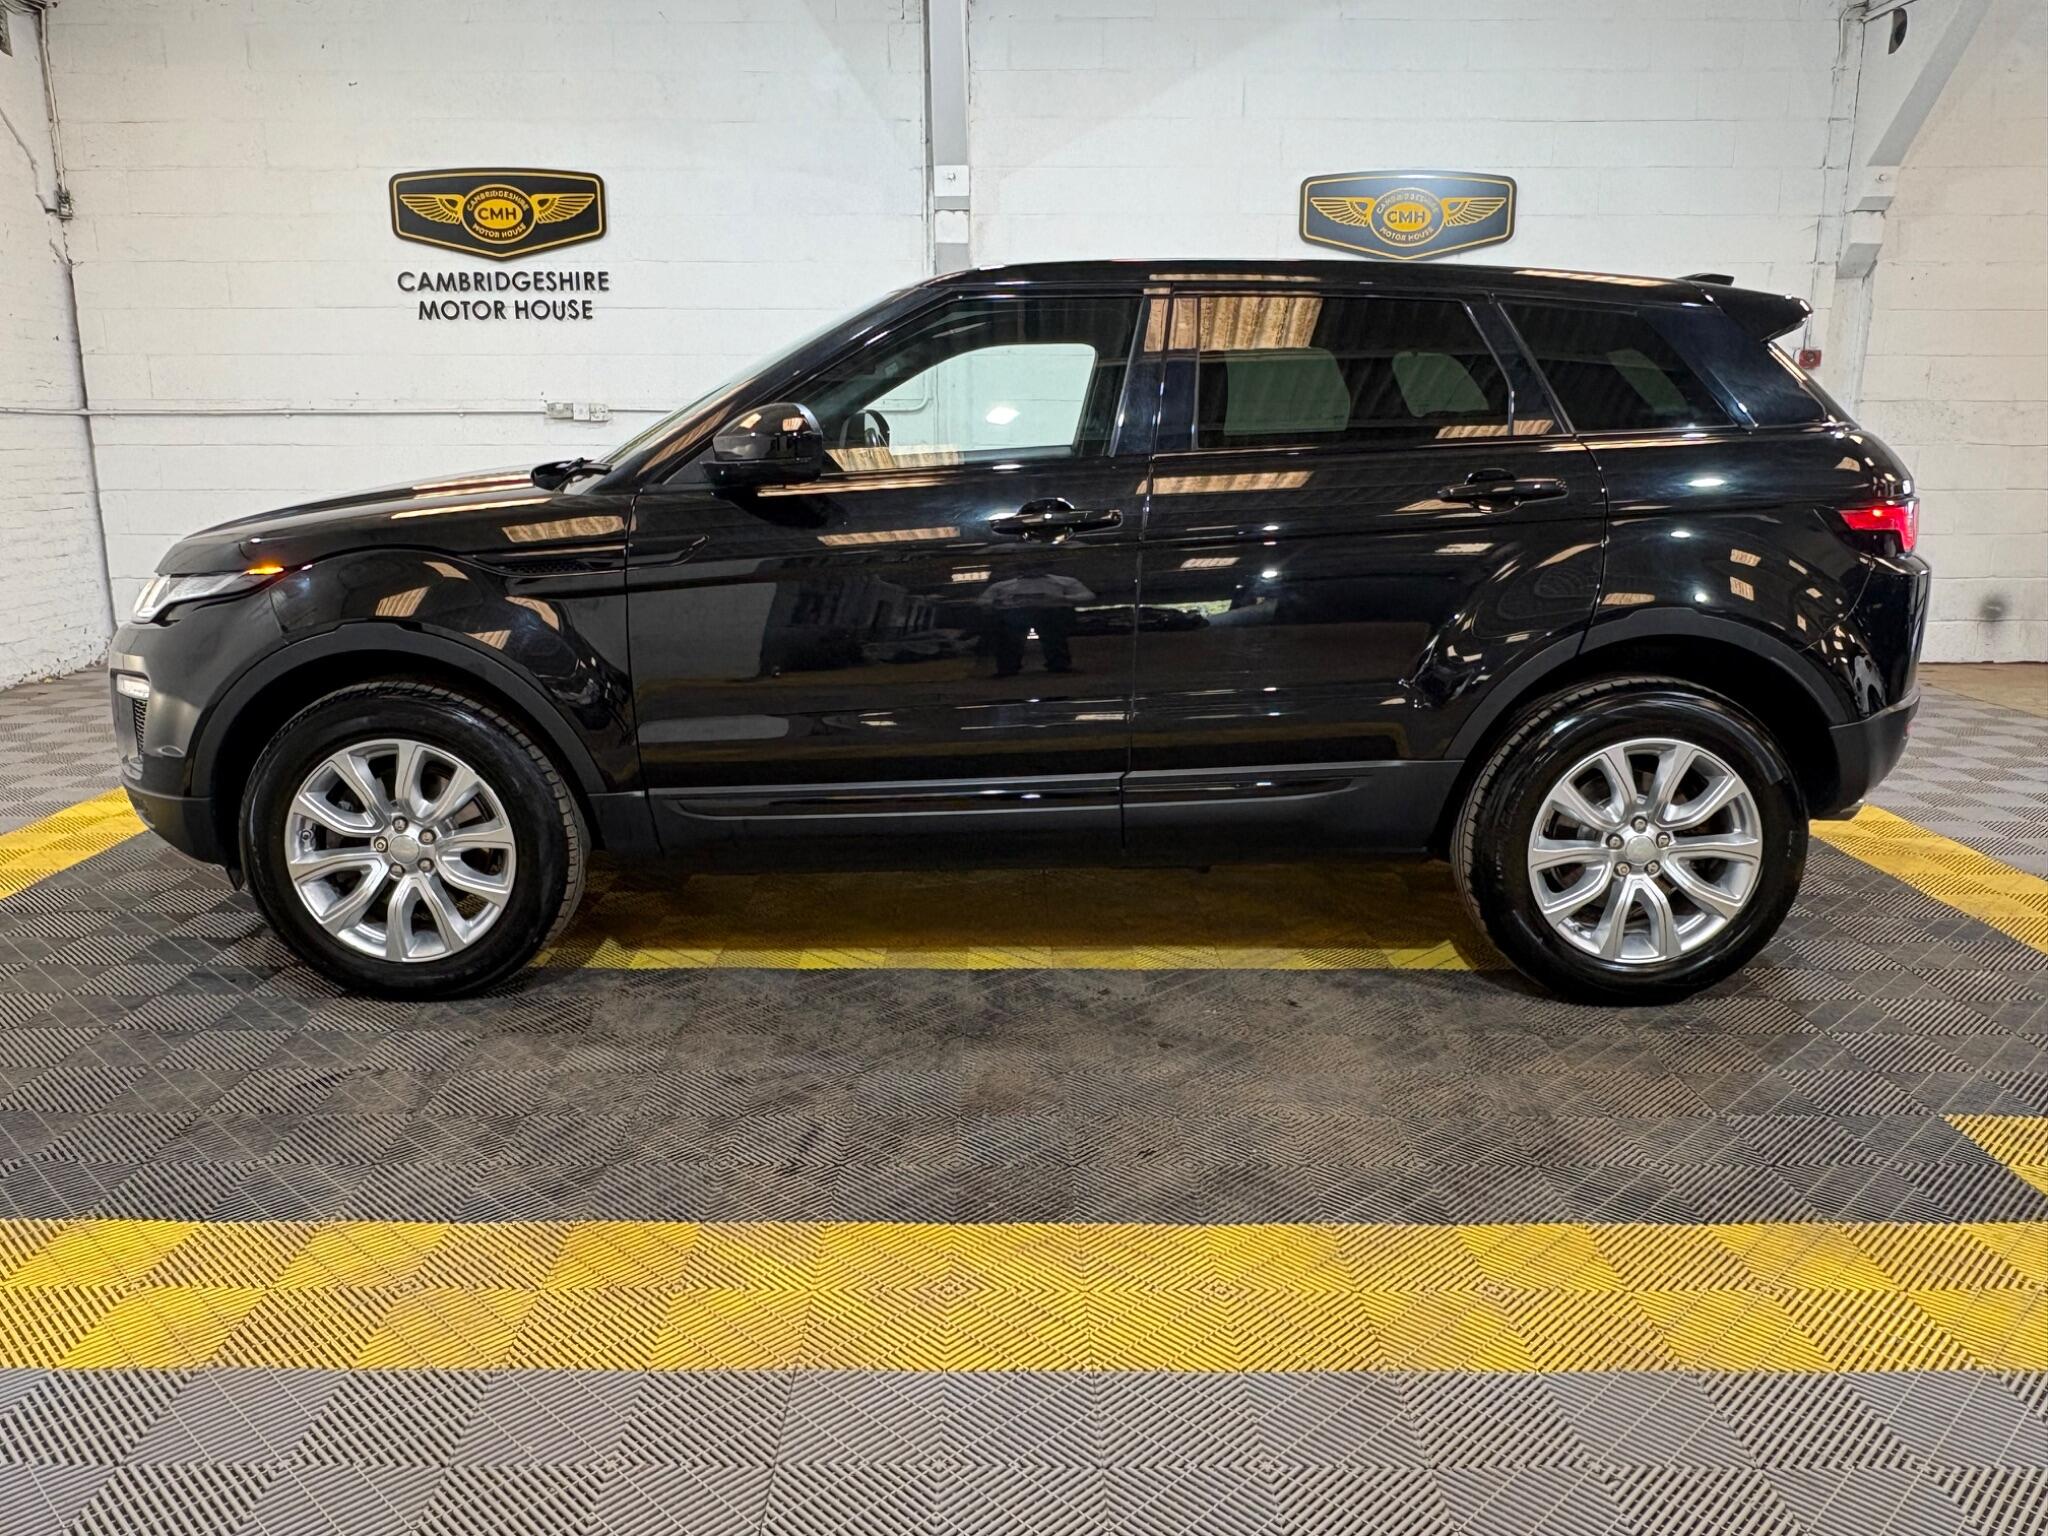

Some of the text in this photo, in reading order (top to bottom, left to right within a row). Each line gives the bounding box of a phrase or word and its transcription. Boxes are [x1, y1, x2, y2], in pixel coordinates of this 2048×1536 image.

[477, 207, 517, 221] CMH
[1386, 210, 1425, 224] CMH
[472, 222, 527, 238] MOTOR HOUSE
[1379, 226, 1406, 241] MOTOR
[397, 271, 610, 292] CAMBRIDGESHIRE
[418, 299, 593, 321] MOTOR HOUSE
